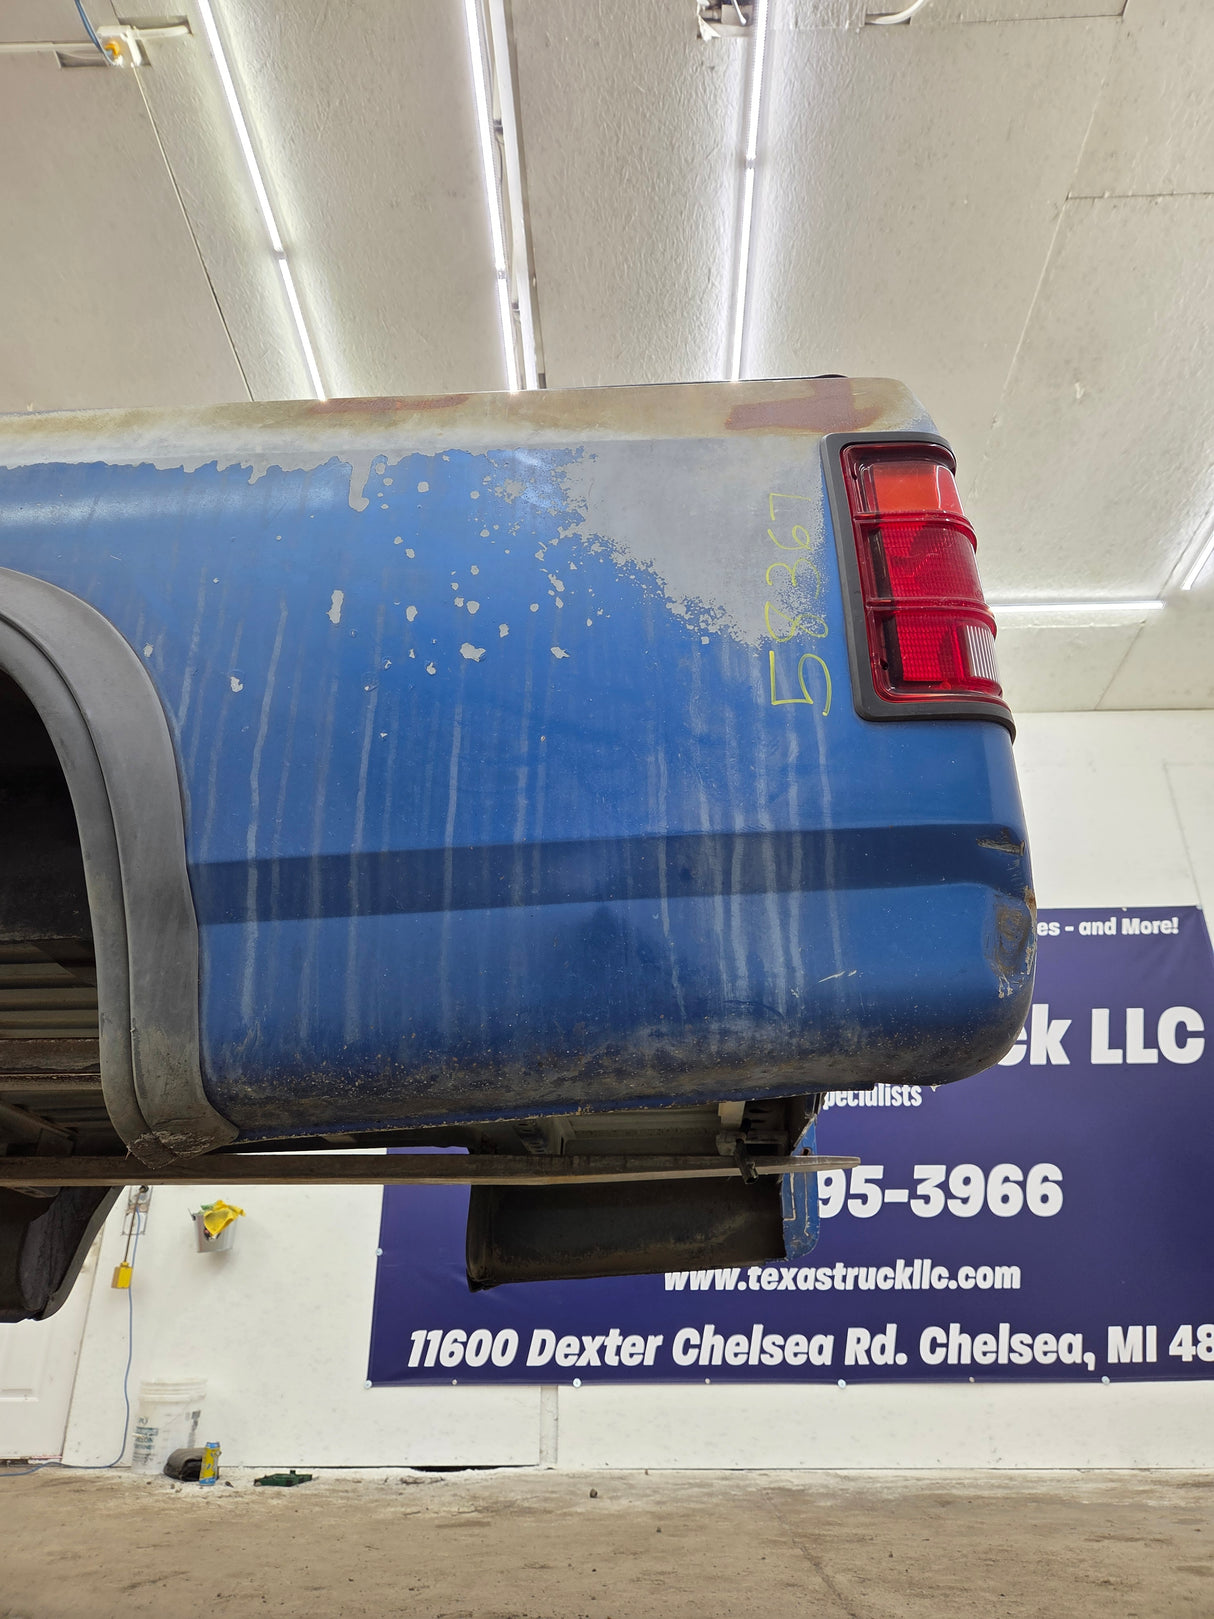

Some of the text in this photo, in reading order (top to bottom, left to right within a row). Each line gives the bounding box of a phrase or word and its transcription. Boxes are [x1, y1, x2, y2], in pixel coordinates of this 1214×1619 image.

[764, 492, 832, 717] 58367
[1079, 917, 1117, 936] and
[1121, 917, 1179, 935] More!
[1091, 1006, 1205, 1065] LLC
[817, 1163, 1063, 1219] 95-3966
[664, 1259, 1021, 1291] www.texastruckllc.com
[407, 1329, 519, 1368] 11600
[526, 1328, 664, 1367] Dexter
[672, 1323, 834, 1366] Chelsea
[844, 1323, 908, 1365] Rd.
[919, 1322, 1096, 1371] Chelsea,
[1107, 1325, 1158, 1363] MI
